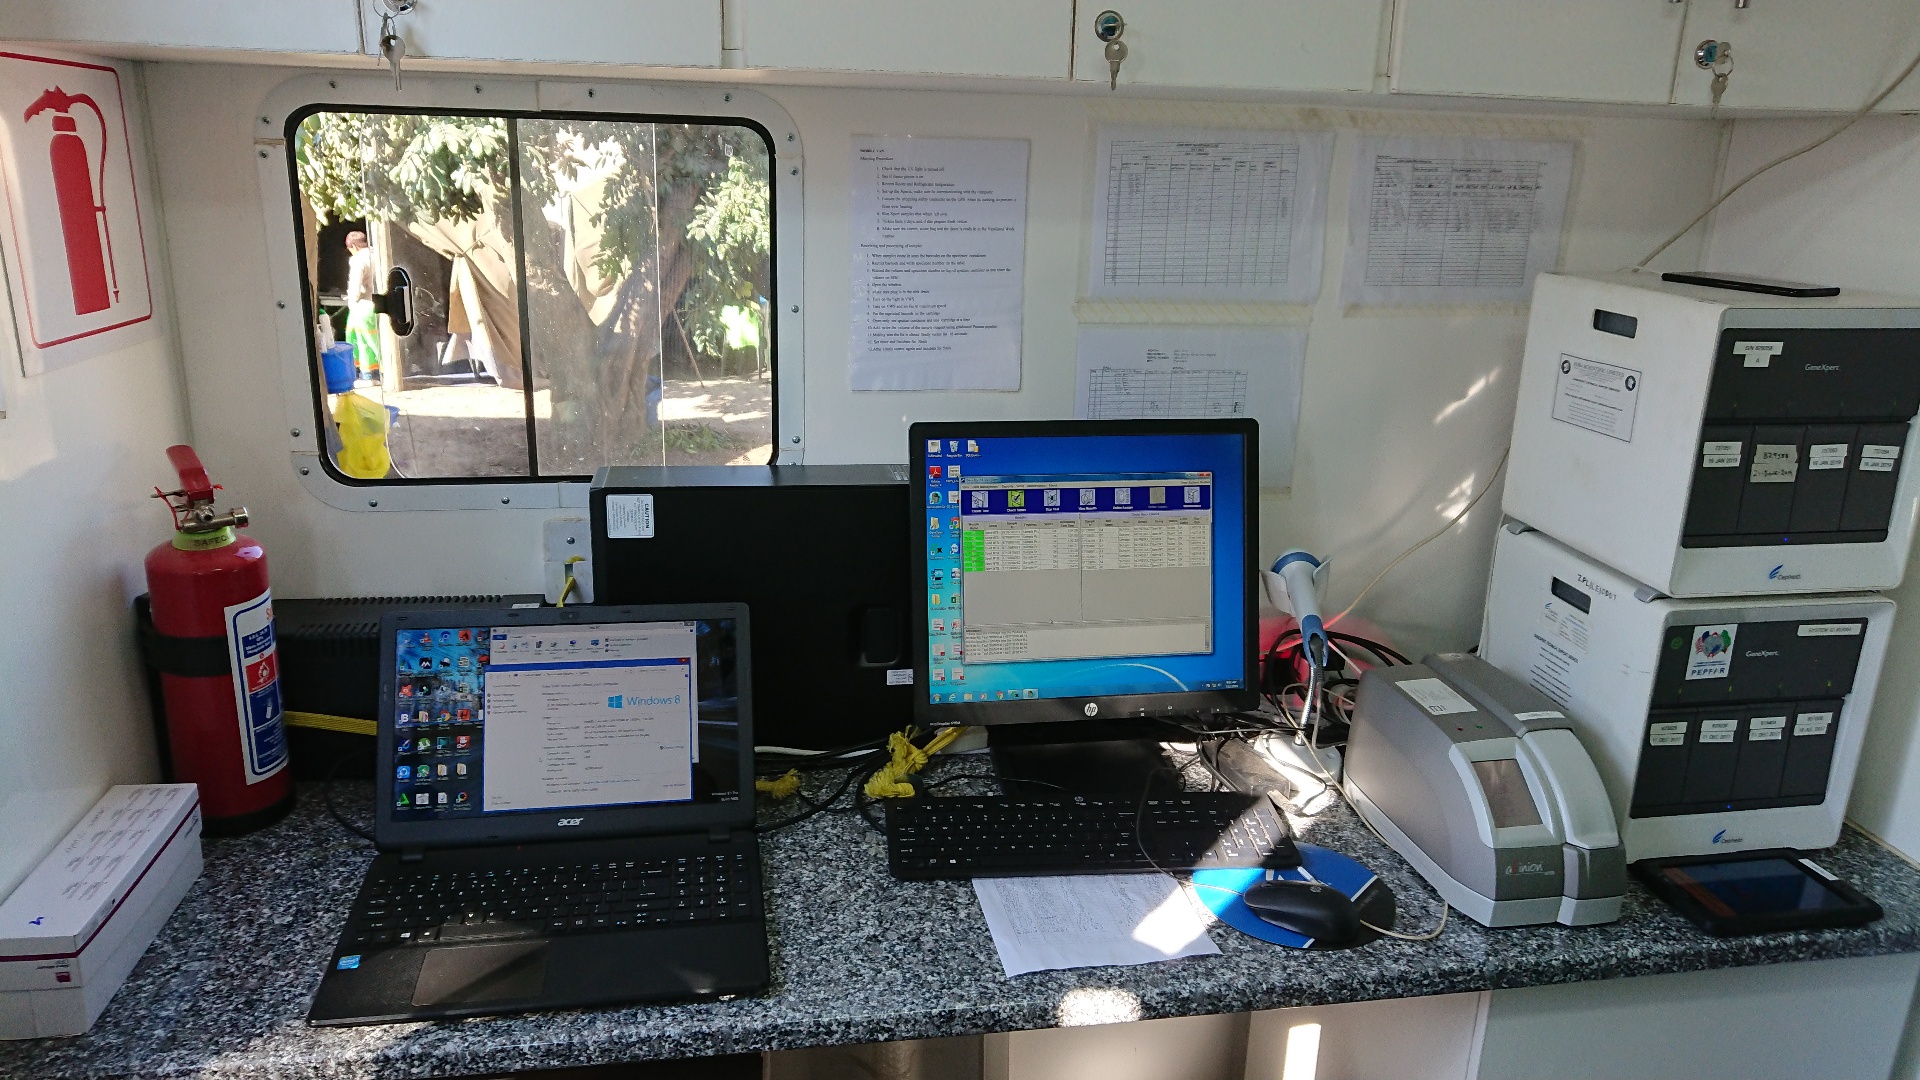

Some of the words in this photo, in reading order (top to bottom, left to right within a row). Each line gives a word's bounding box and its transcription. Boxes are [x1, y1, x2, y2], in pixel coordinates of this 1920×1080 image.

[1804, 364, 1840, 372] GeneXpert
[626, 696, 672, 706] Windows
[674, 694, 681, 705] 8
[1085, 702, 1098, 717] hp
[557, 817, 584, 827] acer
